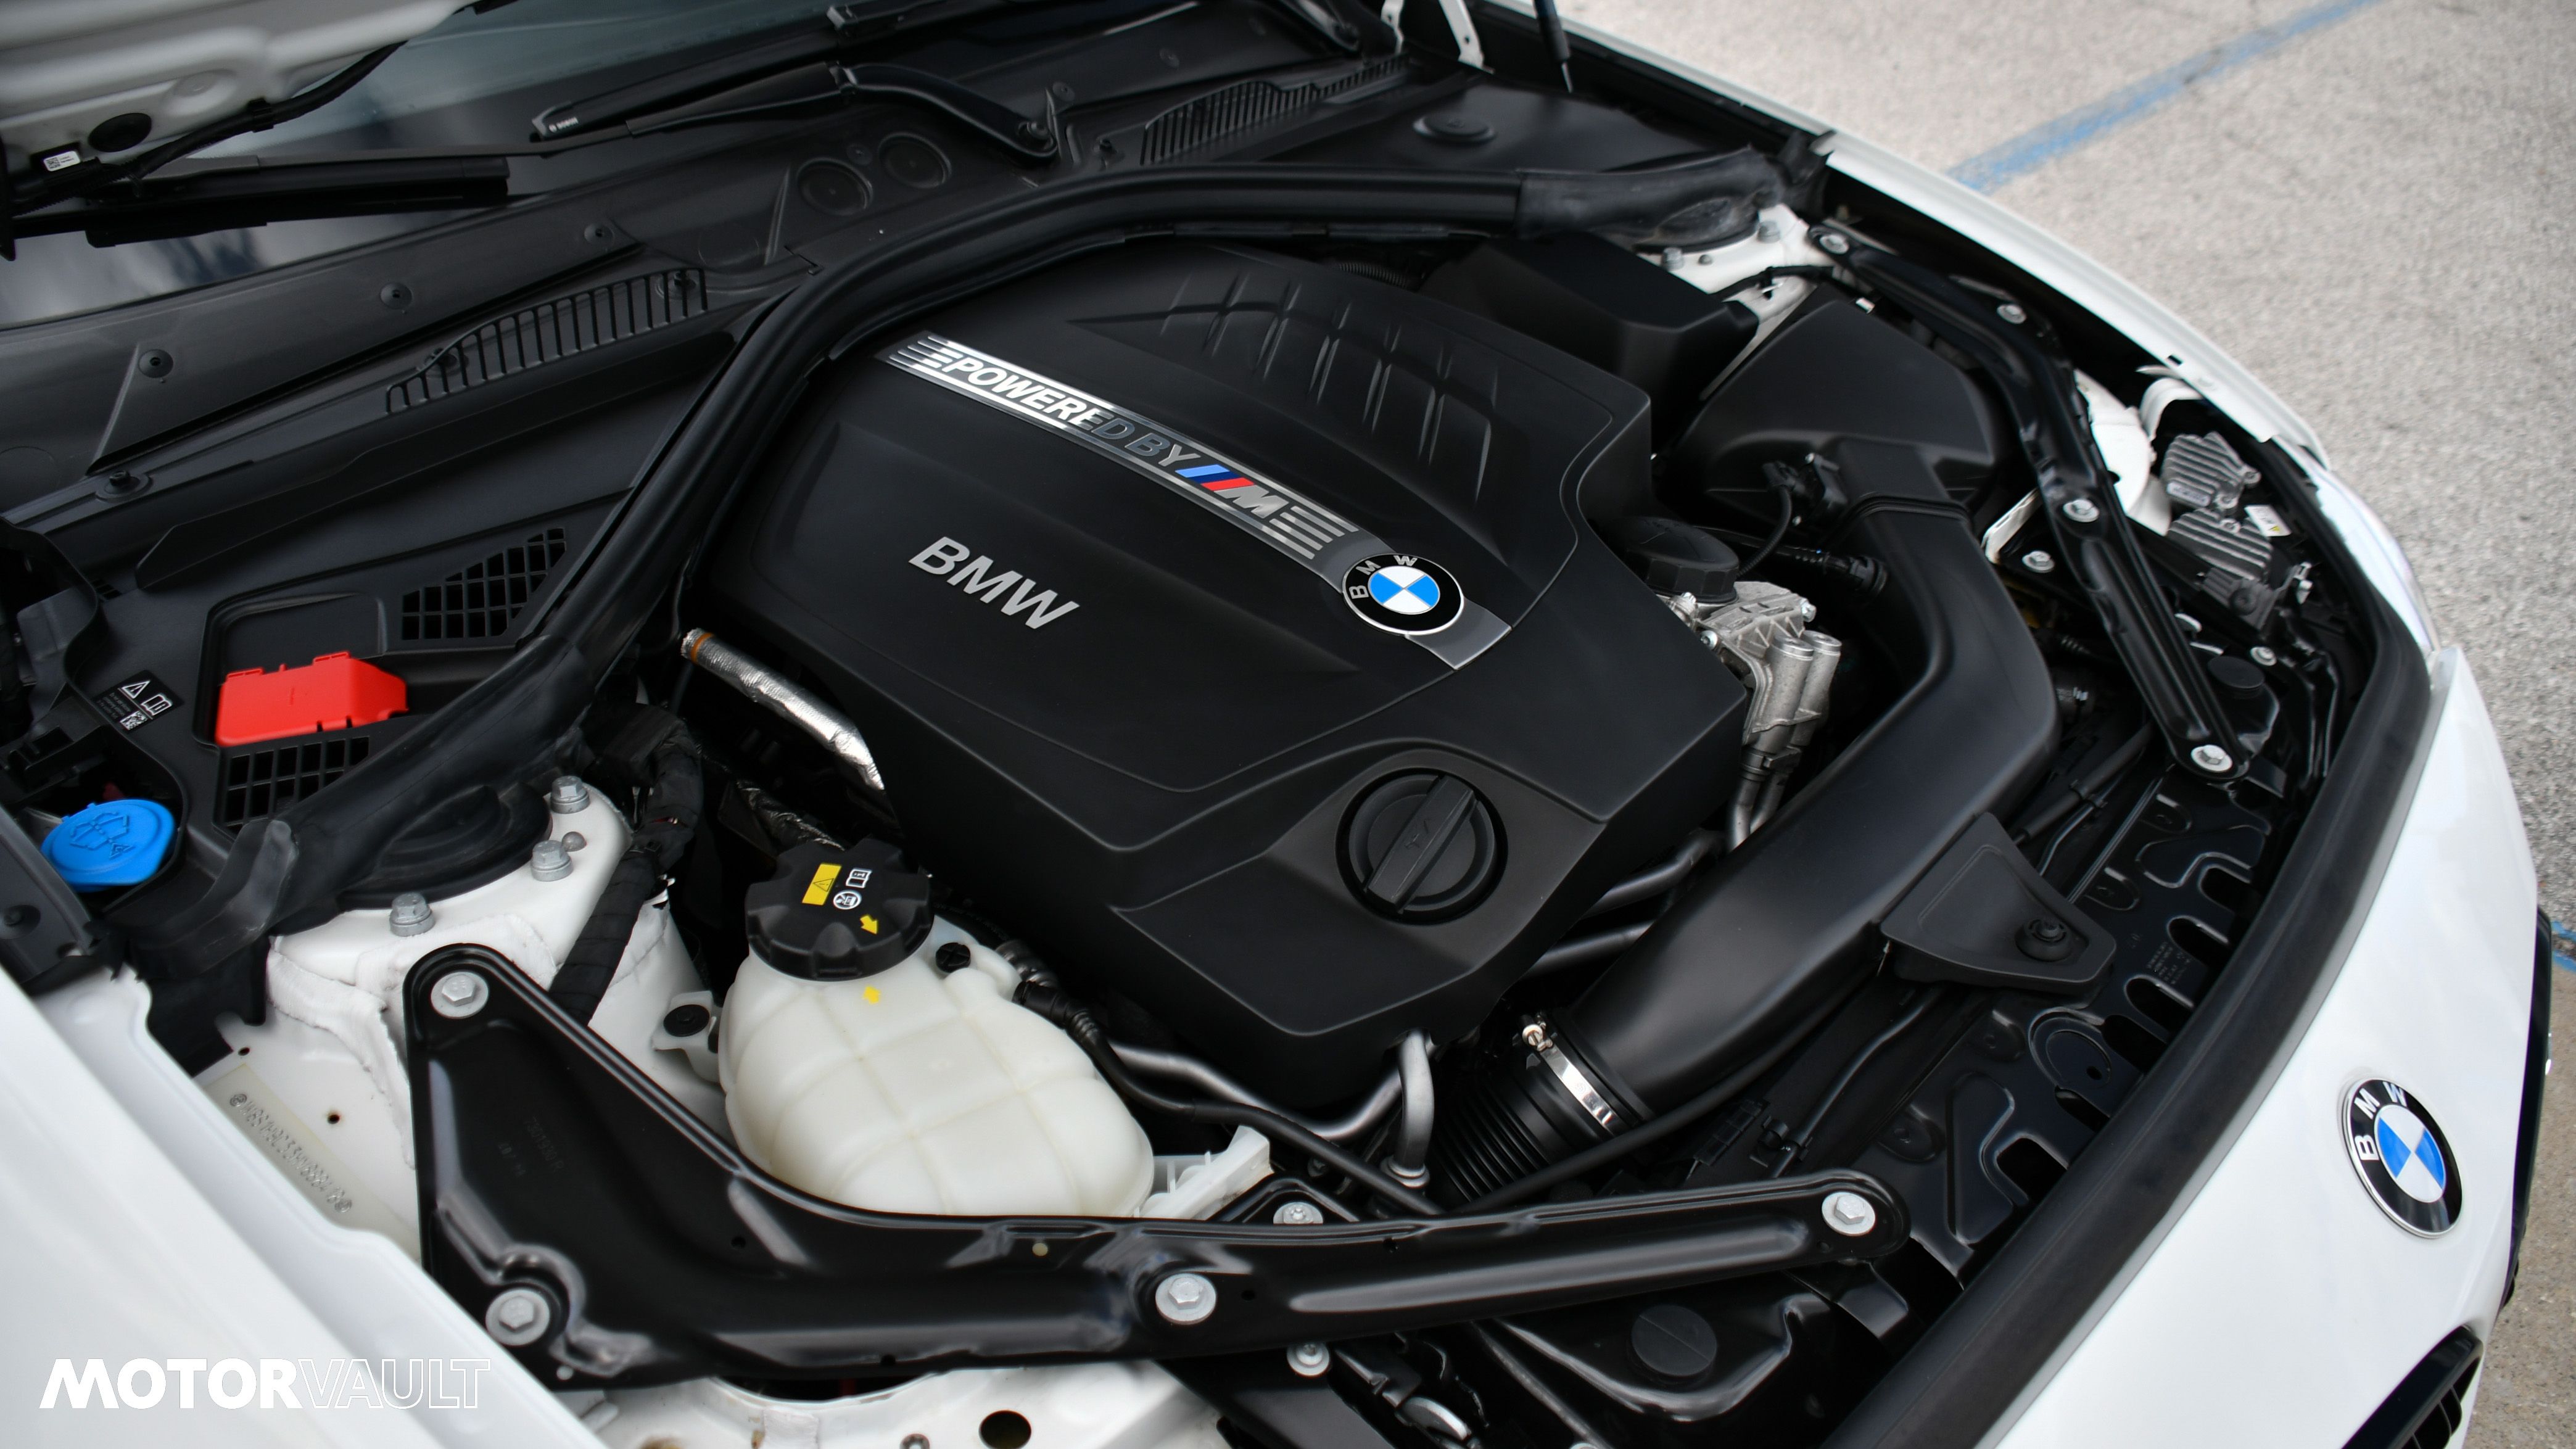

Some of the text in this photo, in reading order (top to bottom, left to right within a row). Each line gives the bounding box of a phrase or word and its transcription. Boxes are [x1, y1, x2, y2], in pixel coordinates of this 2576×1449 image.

[943, 353, 1135, 442] POWERED
[1126, 431, 1201, 468] BY
[907, 536, 1080, 630] BMW
[1348, 554, 1418, 600] BMW
[2353, 1081, 2408, 1161] BMW
